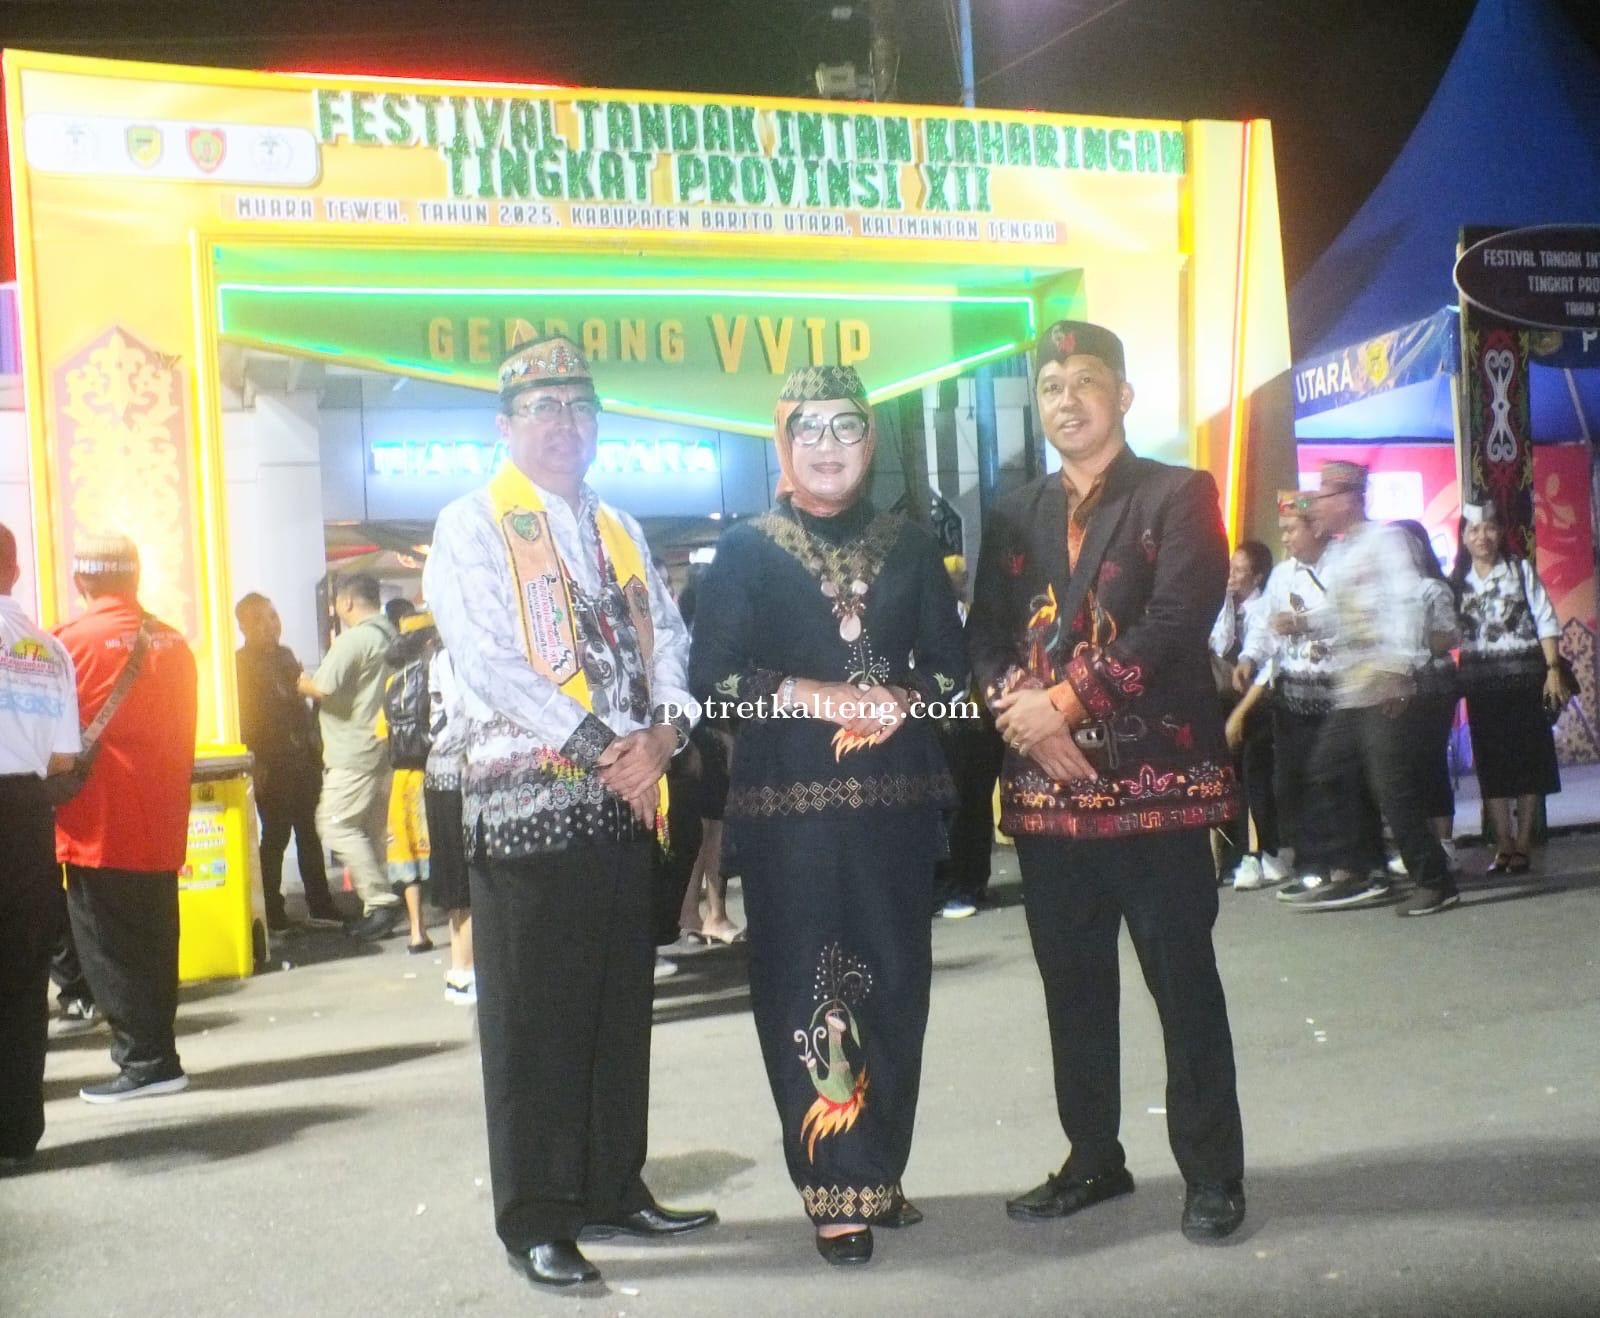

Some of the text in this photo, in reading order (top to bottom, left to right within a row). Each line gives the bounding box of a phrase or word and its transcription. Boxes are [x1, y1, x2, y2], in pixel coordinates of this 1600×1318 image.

[316, 89, 1187, 175] FESTIVAL TANDAK INTAN KAHARINGAN
[445, 145, 993, 213] TINGKAT PROVINSI XII
[237, 197, 313, 218] MUARA
[420, 202, 488, 223] TAHUN
[571, 206, 690, 228] KABUPATEN
[701, 212, 773, 231] BARITO
[862, 216, 979, 238] KALIMANTAN
[989, 222, 1057, 241] TENGAH
[1483, 248, 1536, 268] FESTIVAL
[1539, 249, 1582, 268] TANDAK
[1528, 275, 1575, 293] TINGKAT
[428, 312, 871, 375] GEANG VVIP
[1295, 357, 1355, 404] UTARA
